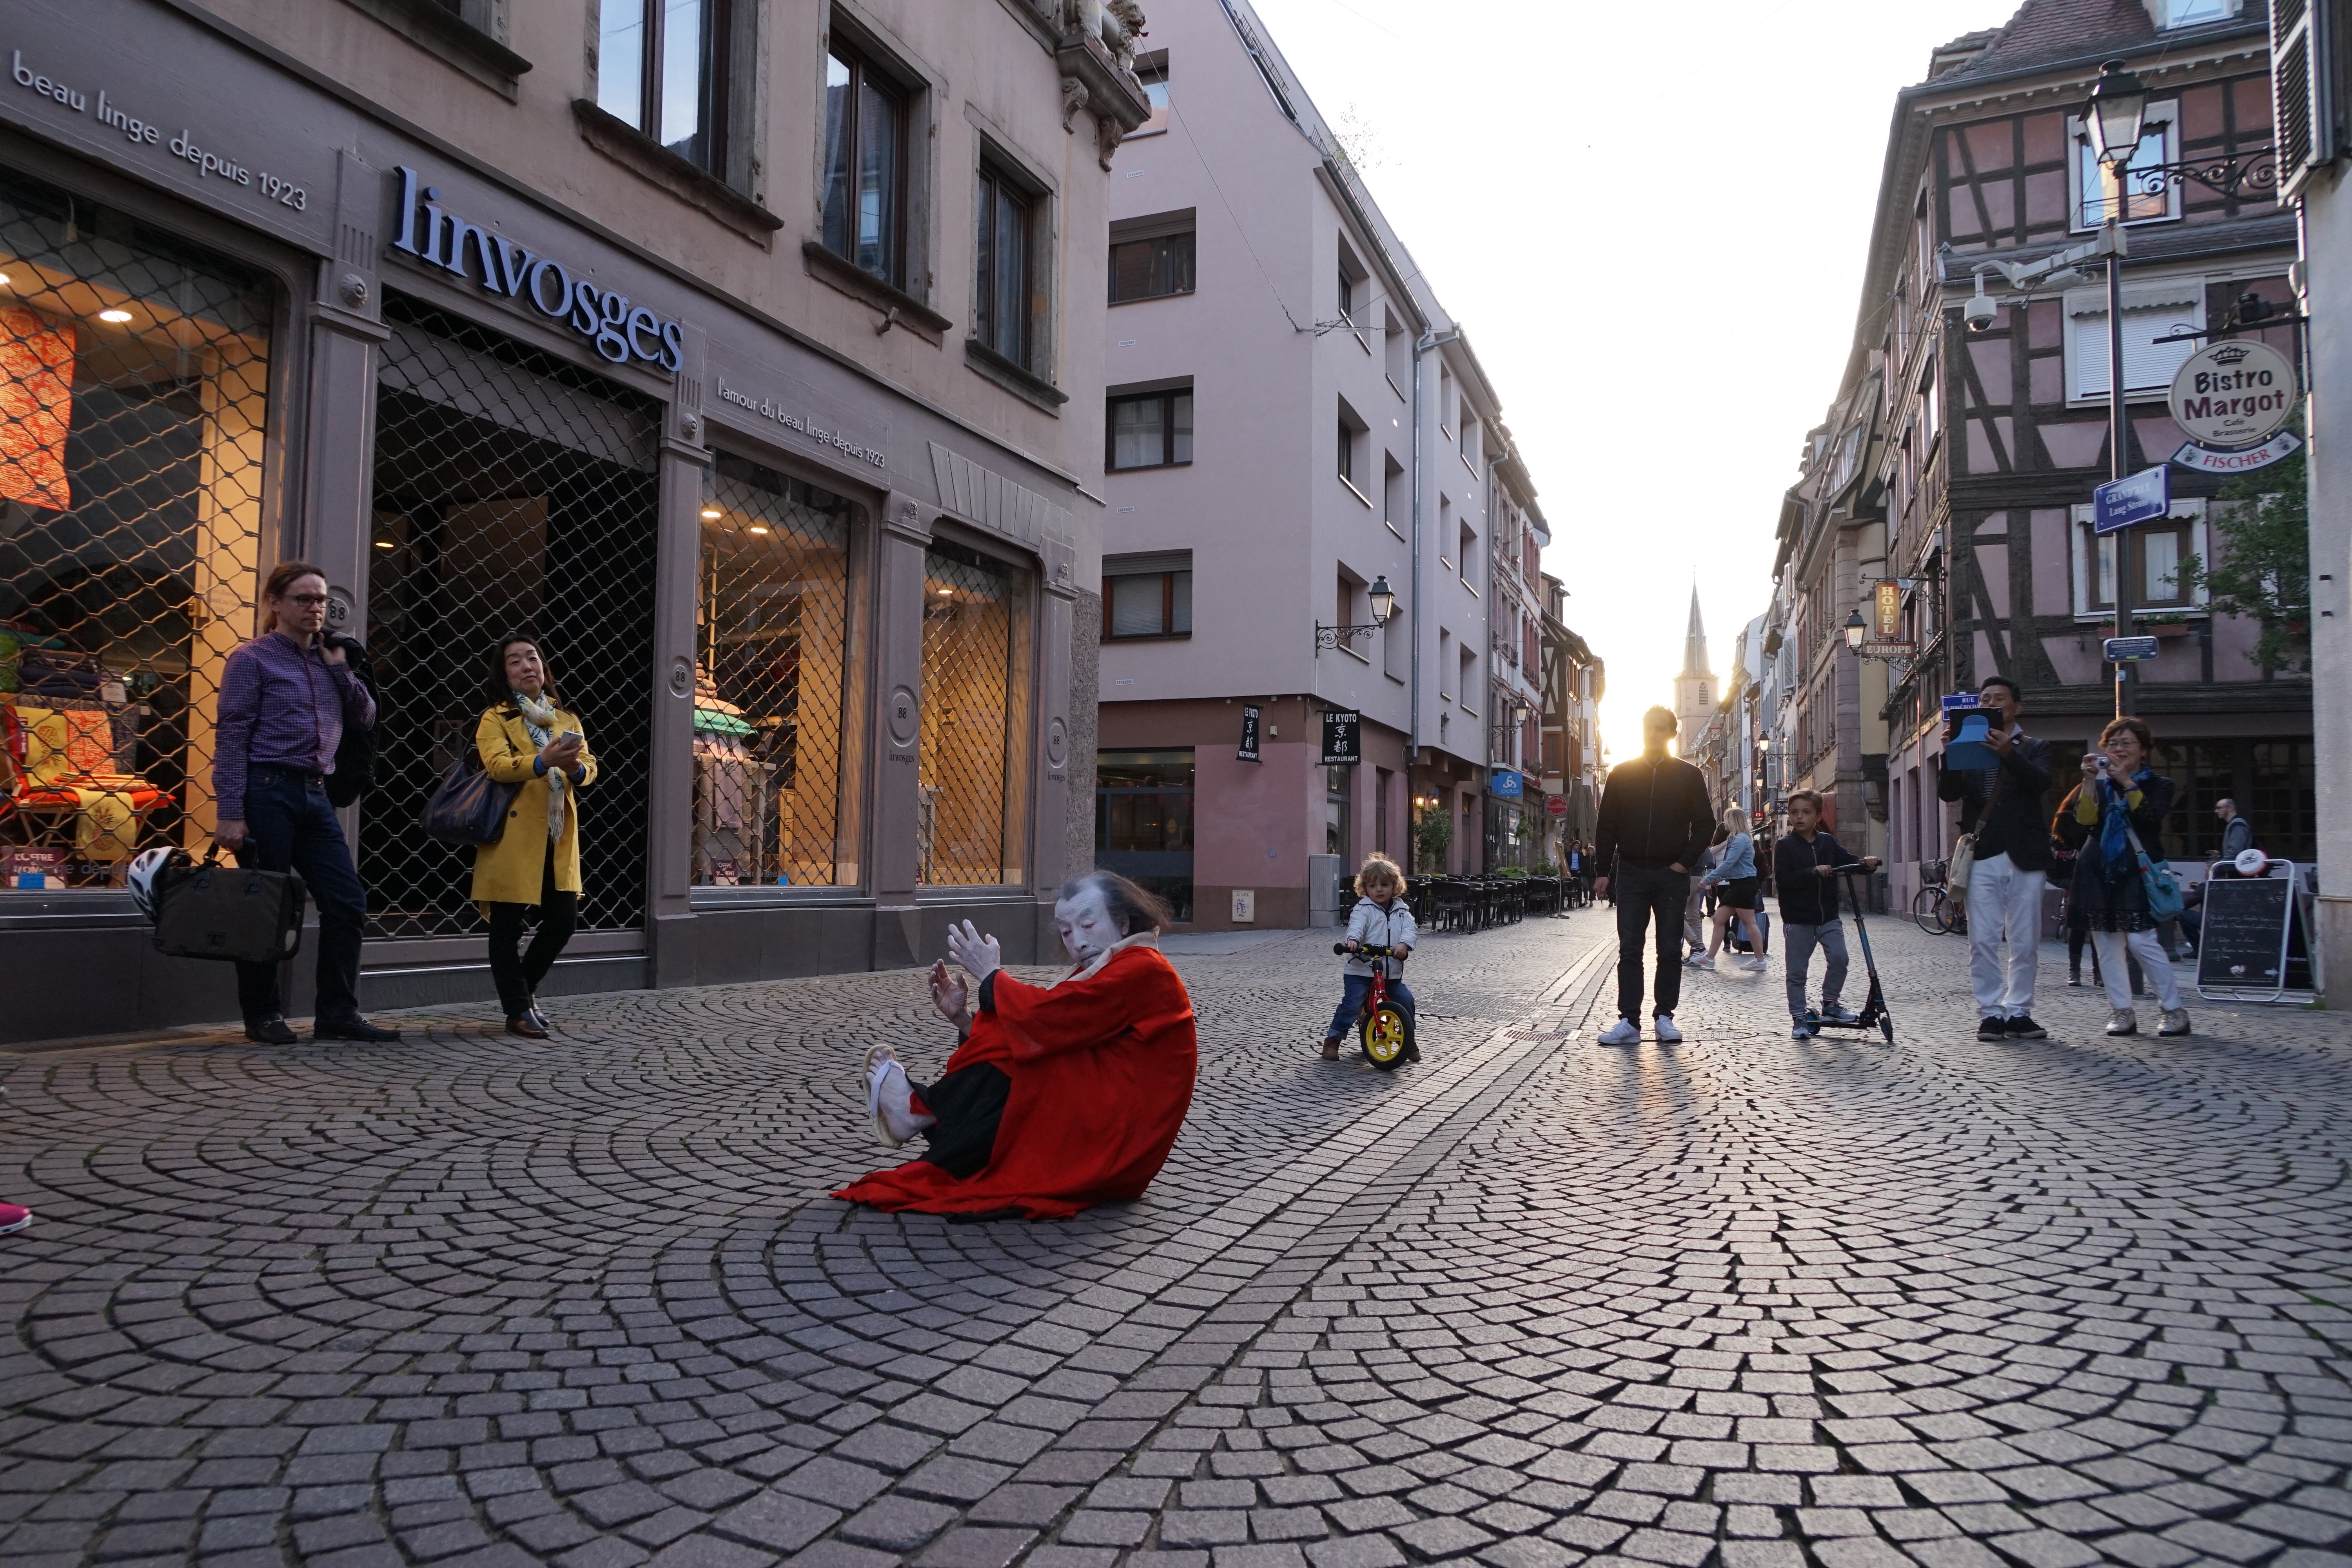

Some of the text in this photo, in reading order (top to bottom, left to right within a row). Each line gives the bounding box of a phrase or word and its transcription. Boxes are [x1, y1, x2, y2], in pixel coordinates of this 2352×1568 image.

[13, 50, 307, 211] beau linge depuis 1923
[392, 165, 684, 372] linvosges
[2195, 370, 2273, 394] Bistro
[2184, 390, 2285, 420] Margot
[718, 377, 884, 467] l'amour du beau linge depuis 1923
[2213, 427, 2257, 437] Brasserie
[2203, 449, 2272, 468] FISCHER
[2109, 506, 2126, 517] Lang
[330, 604, 345, 620] 88
[1882, 586, 1894, 633] HOTEL
[1866, 645, 1911, 654] EUROPE
[676, 670, 685, 682] 88
[898, 706, 907, 719] 88
[1245, 707, 1258, 719] LE KYOTO
[1326, 713, 1357, 723] LE KYOTO
[1053, 734, 1060, 744] 88
[1334, 723, 1347, 755] 京都
[889, 749, 915, 766] linvosges
[1238, 750, 1258, 759] RESTAURANT
